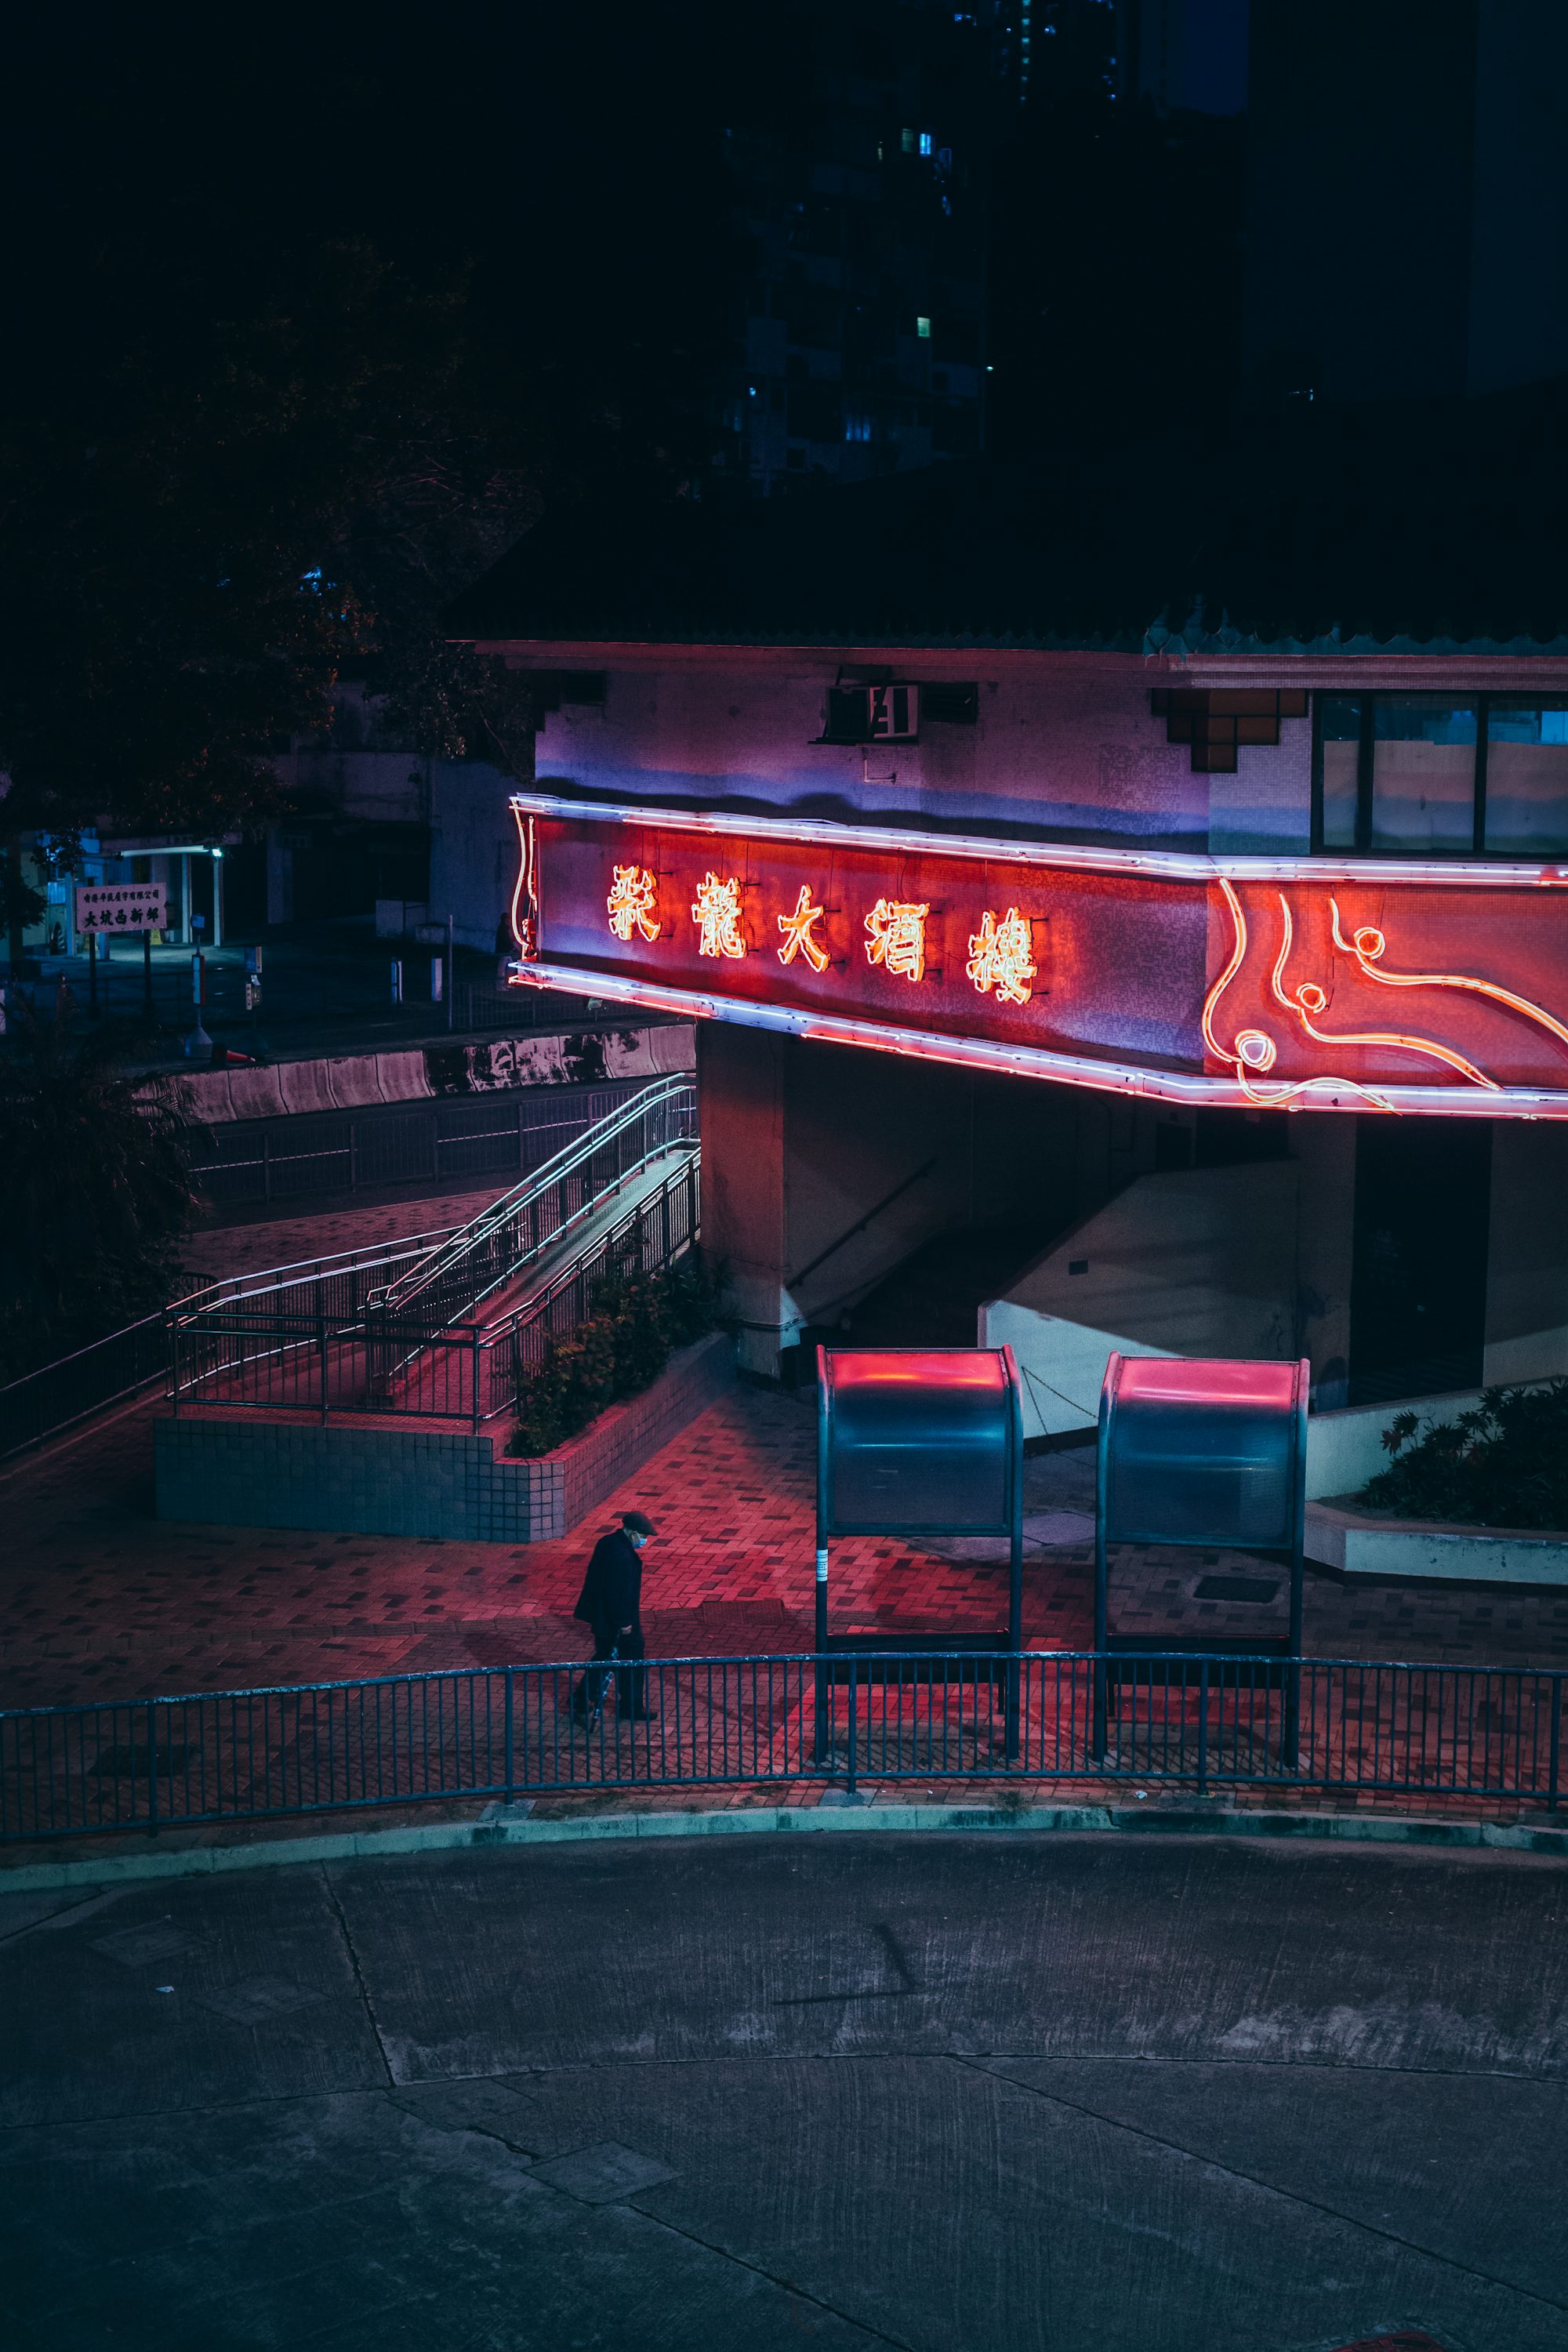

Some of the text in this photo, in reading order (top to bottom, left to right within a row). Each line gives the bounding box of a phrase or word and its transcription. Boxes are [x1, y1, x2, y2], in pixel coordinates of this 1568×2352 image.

[85, 907, 159, 927] 大坑西新邨
